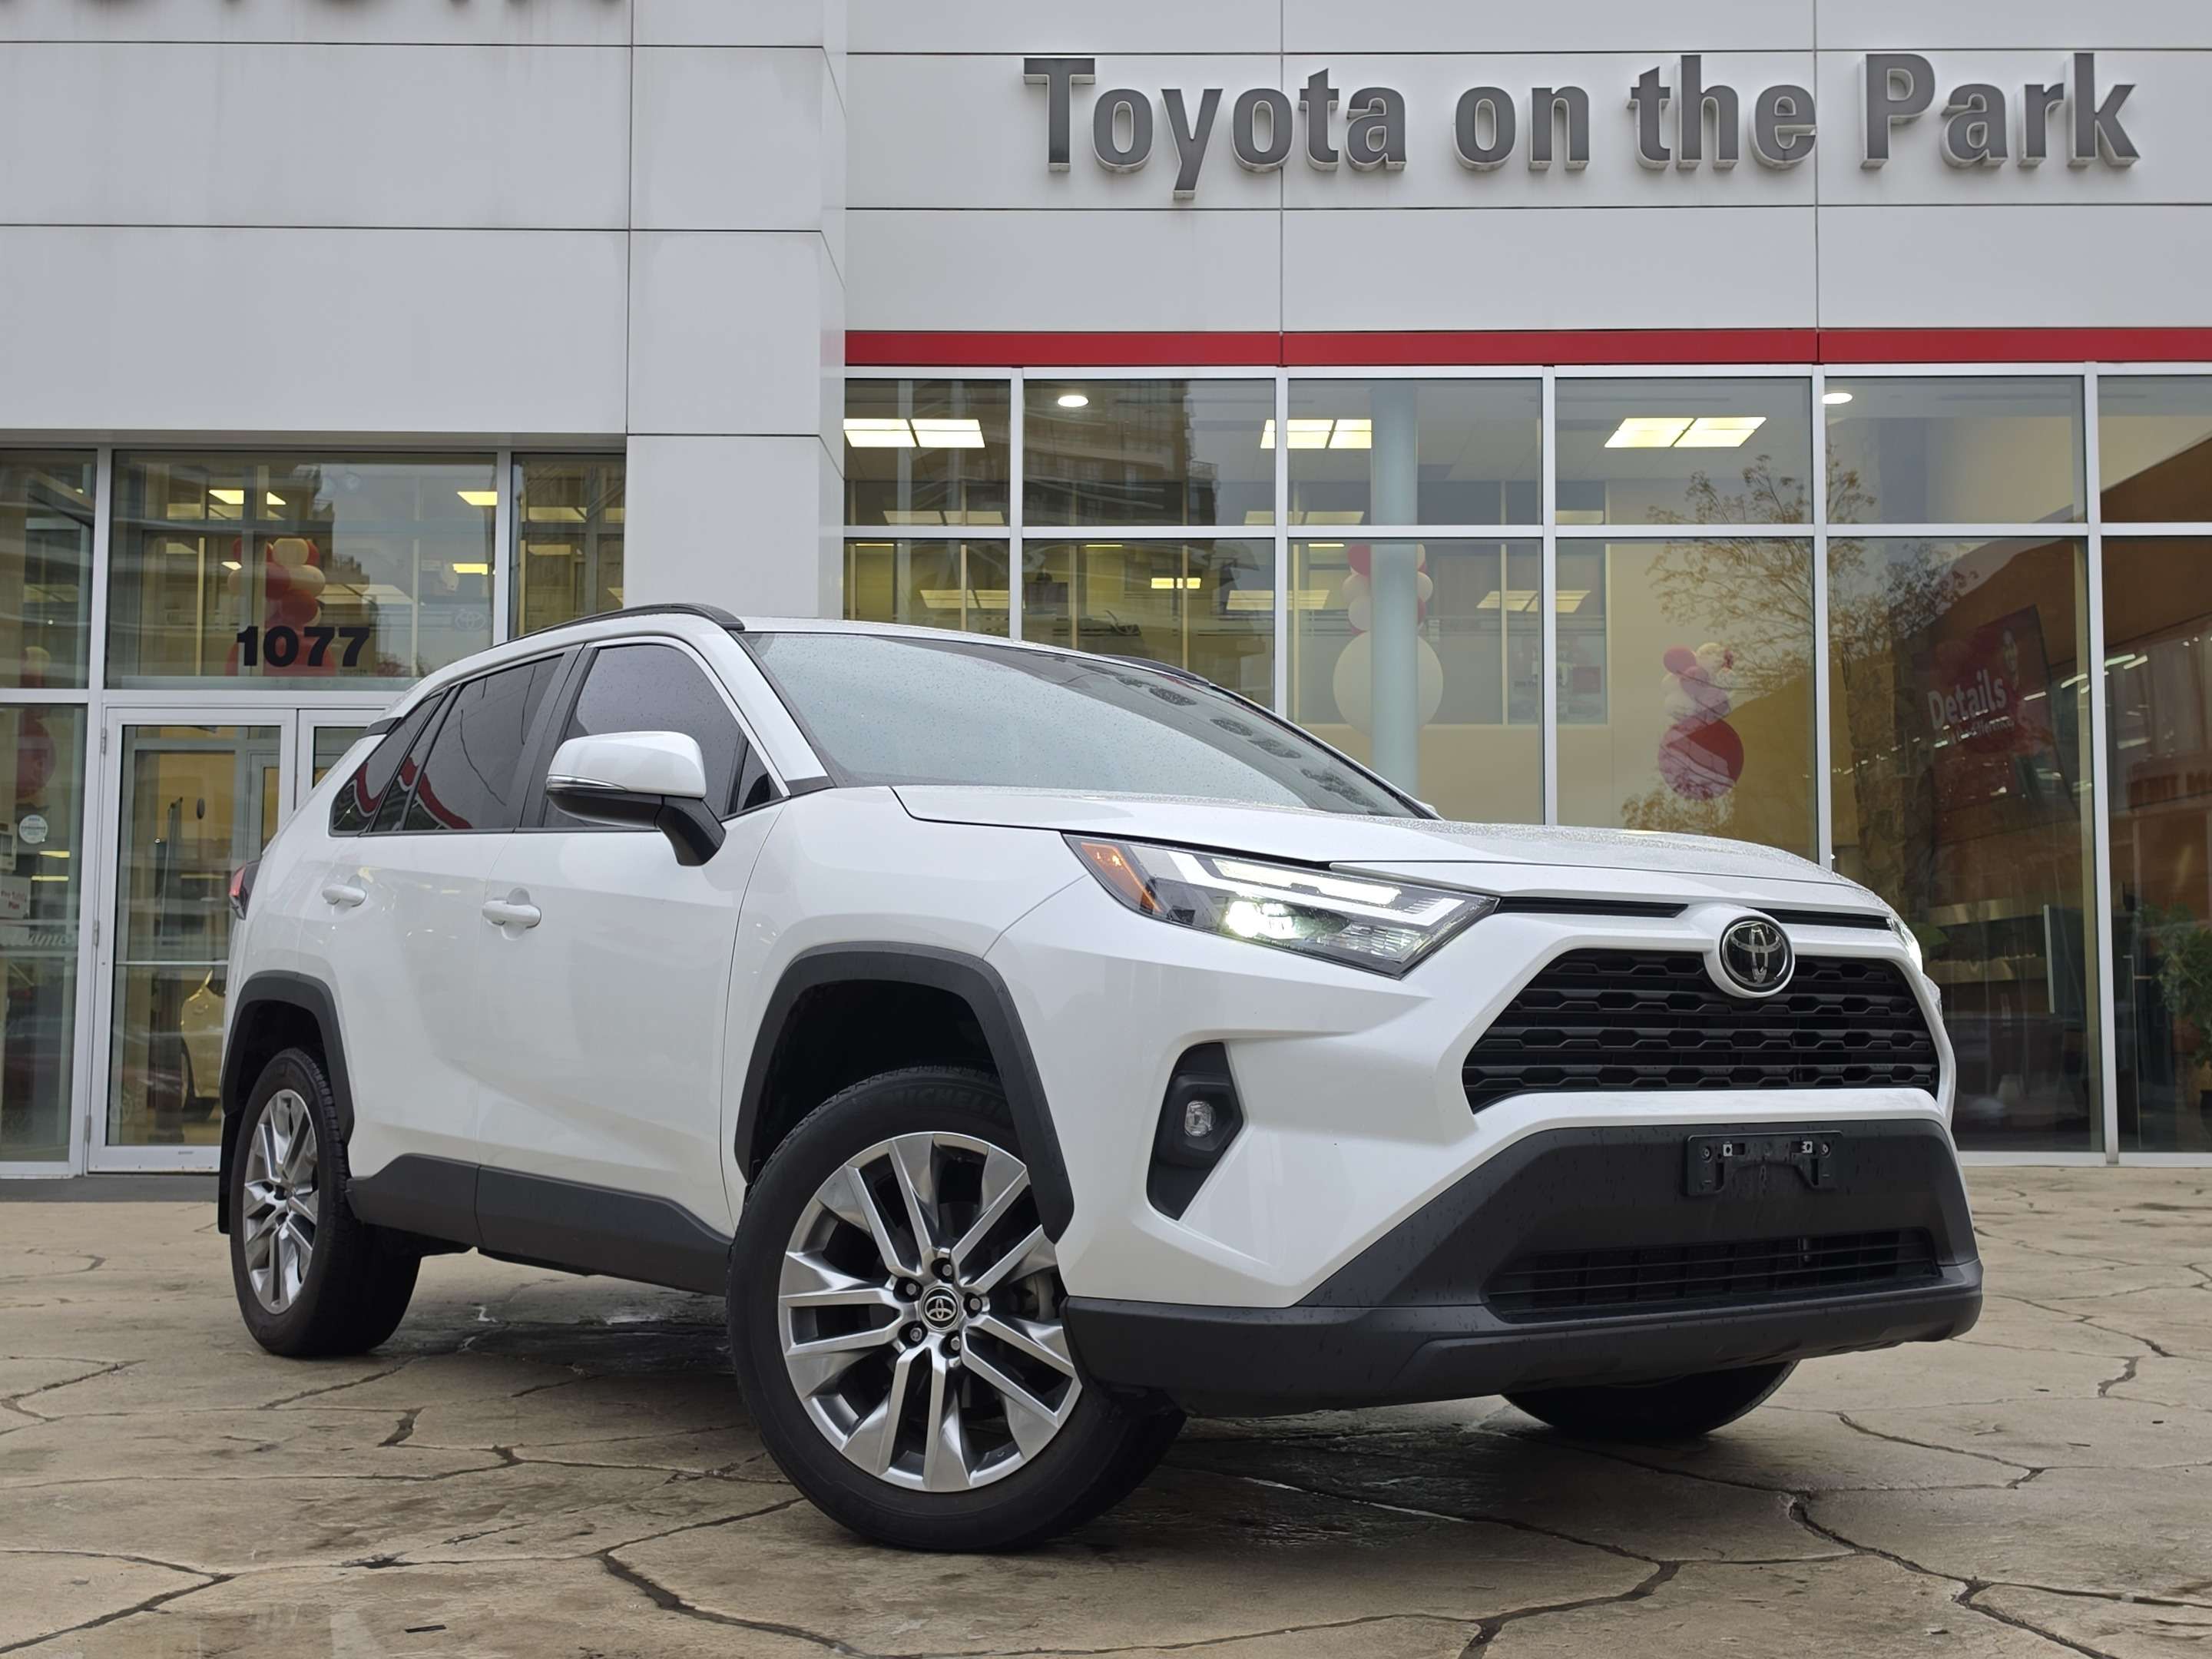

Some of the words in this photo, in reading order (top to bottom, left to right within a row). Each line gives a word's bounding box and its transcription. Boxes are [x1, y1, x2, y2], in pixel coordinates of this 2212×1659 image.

[1023, 58, 1406, 199] Toyota
[1453, 86, 1590, 171] on
[1627, 55, 1816, 171] the
[1860, 52, 2141, 170] Park
[237, 625, 370, 667] 1077
[1927, 668, 2007, 730] Details
